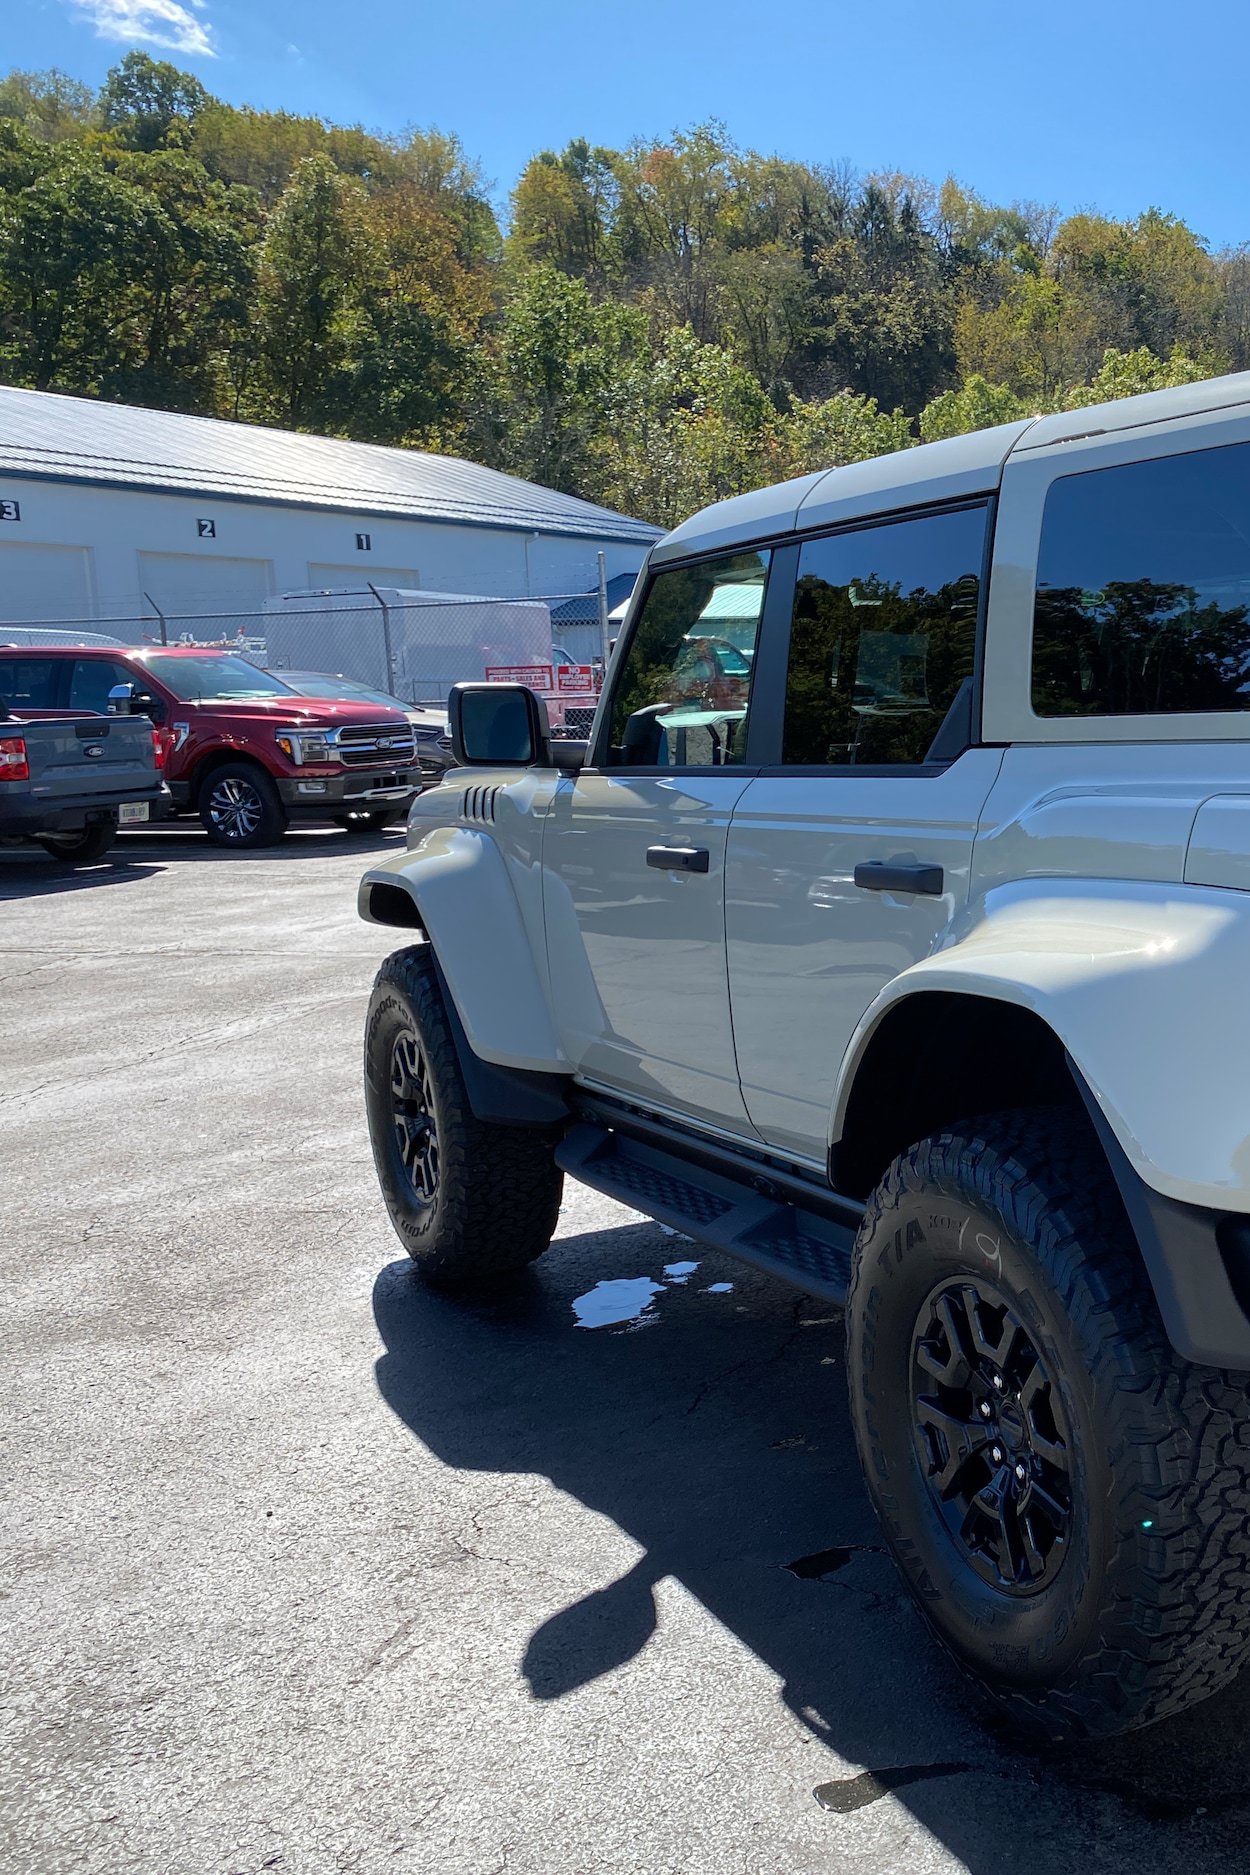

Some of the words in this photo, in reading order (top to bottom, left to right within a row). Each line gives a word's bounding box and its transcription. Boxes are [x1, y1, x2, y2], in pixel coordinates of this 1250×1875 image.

[2, 501, 17, 519] 3
[200, 520, 214, 537] 2
[359, 535, 367, 550] 1
[877, 1217, 927, 1278] T/A
